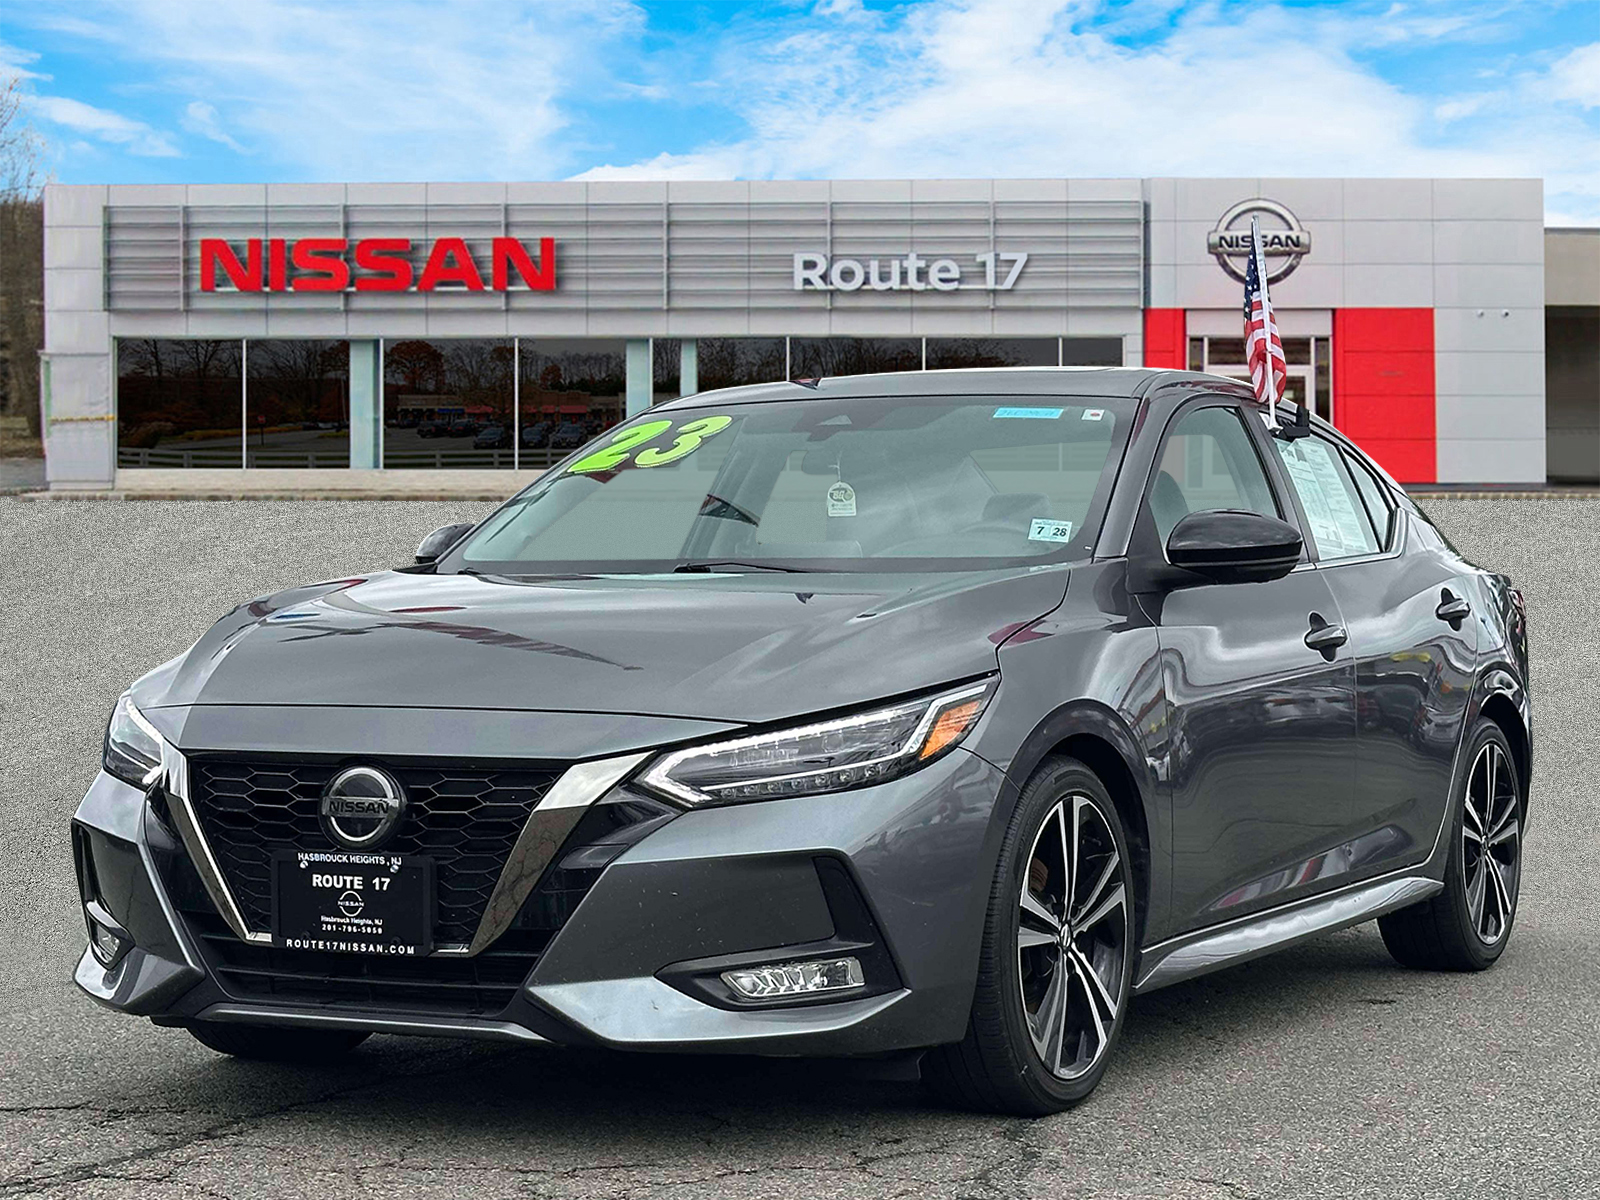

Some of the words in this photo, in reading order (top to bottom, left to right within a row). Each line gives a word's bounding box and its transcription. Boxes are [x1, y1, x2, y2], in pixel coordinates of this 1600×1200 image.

[201, 237, 555, 291] NISSAN
[793, 252, 961, 291] Route
[975, 252, 1028, 290] 17
[567, 415, 733, 474] 23
[1037, 526, 1045, 535] 7
[1052, 527, 1067, 537] 28
[329, 801, 389, 814] NISSAN
[298, 852, 349, 864] HASBROUCK
[391, 856, 402, 866] NJ
[312, 874, 363, 889] ROUTE
[372, 877, 391, 891] 17
[286, 939, 415, 955] ROUTE17NISSAN.COM
